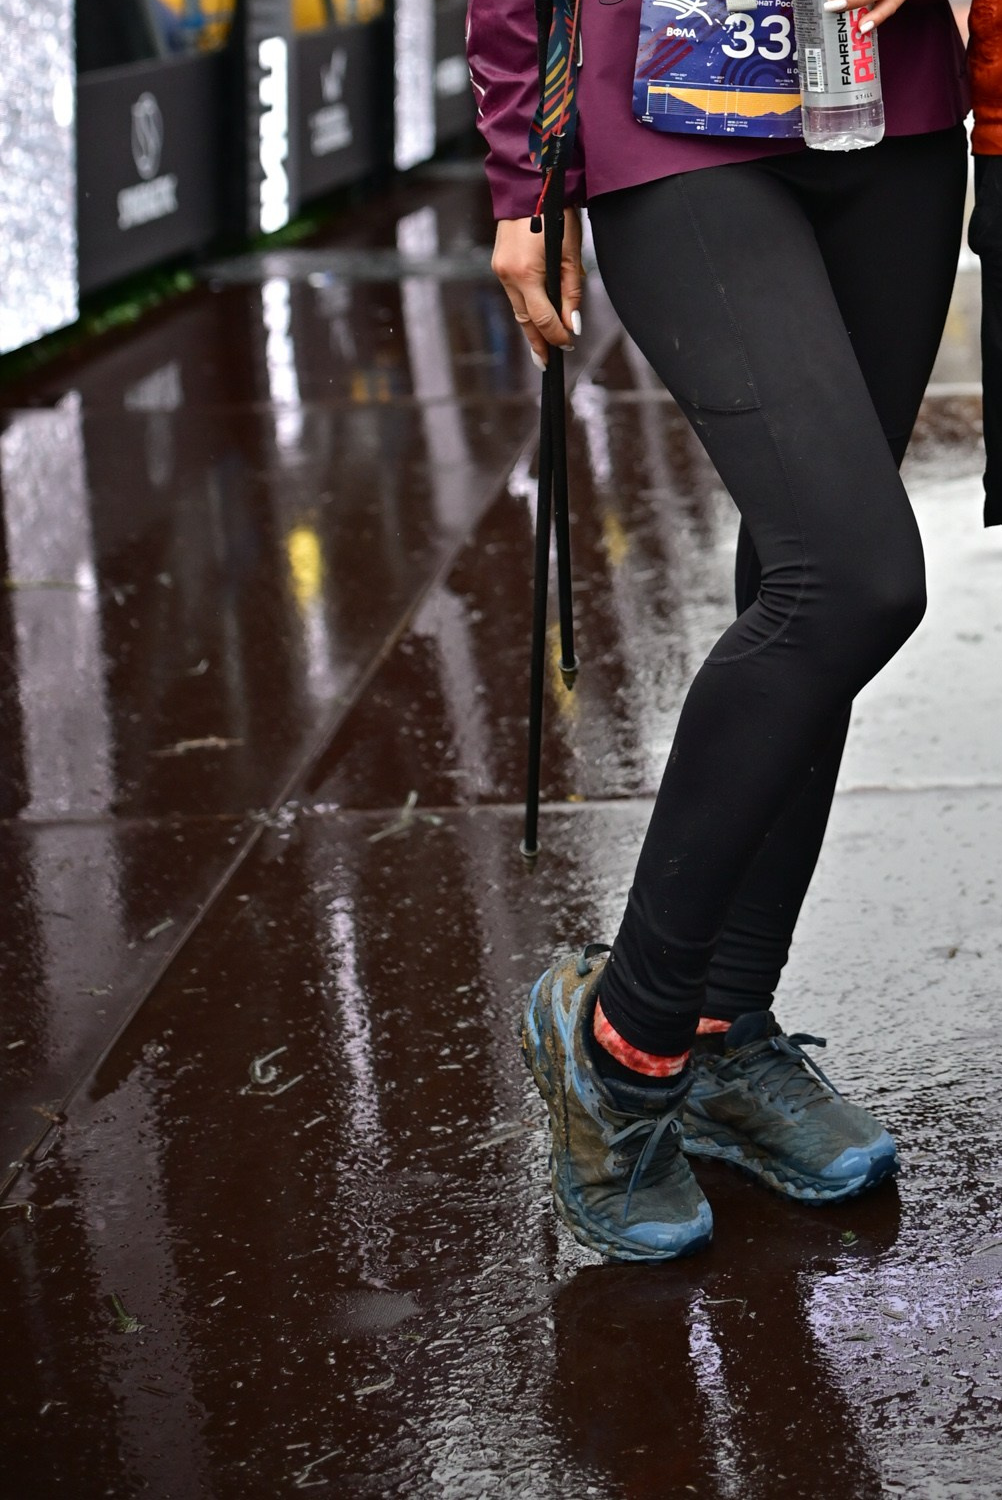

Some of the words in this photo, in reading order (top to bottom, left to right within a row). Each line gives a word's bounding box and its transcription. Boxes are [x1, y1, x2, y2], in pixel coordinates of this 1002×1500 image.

[666, 27, 697, 39] ВФЛА
[721, 12, 797, 61] 33
[855, 92, 873, 100] STILL
